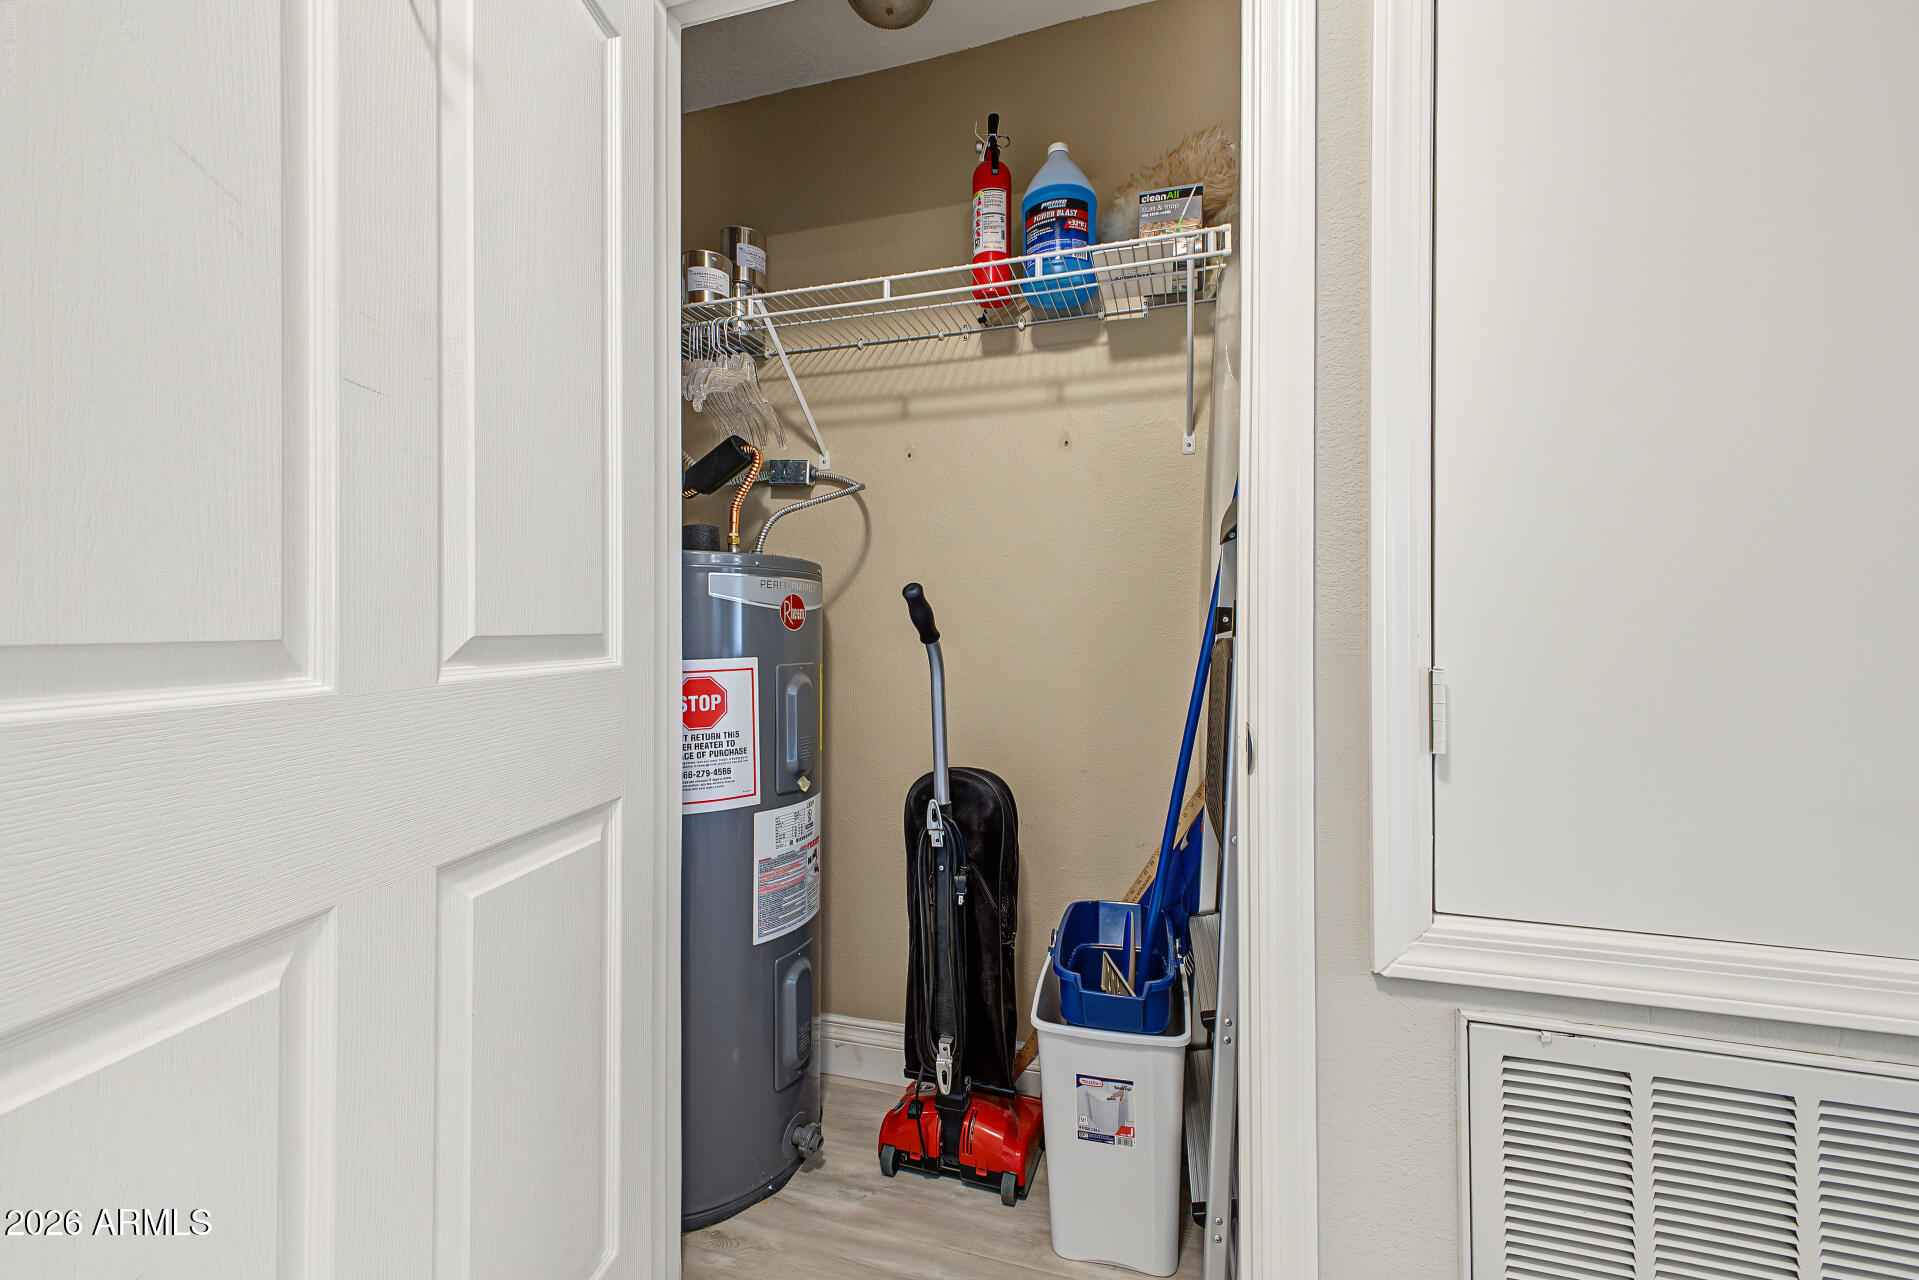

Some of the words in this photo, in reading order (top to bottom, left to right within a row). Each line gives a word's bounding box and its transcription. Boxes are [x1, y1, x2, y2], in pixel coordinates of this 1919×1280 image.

[1141, 190, 1180, 203] cleanAll
[1056, 209, 1078, 217] BLAST
[682, 694, 722, 713] STOP
[690, 732, 721, 742] RETURN
[723, 730, 740, 739] THIS
[694, 740, 724, 750] HEATER
[726, 739, 736, 747] TO
[696, 751, 706, 759] OF
[709, 747, 748, 758] PURCHASE
